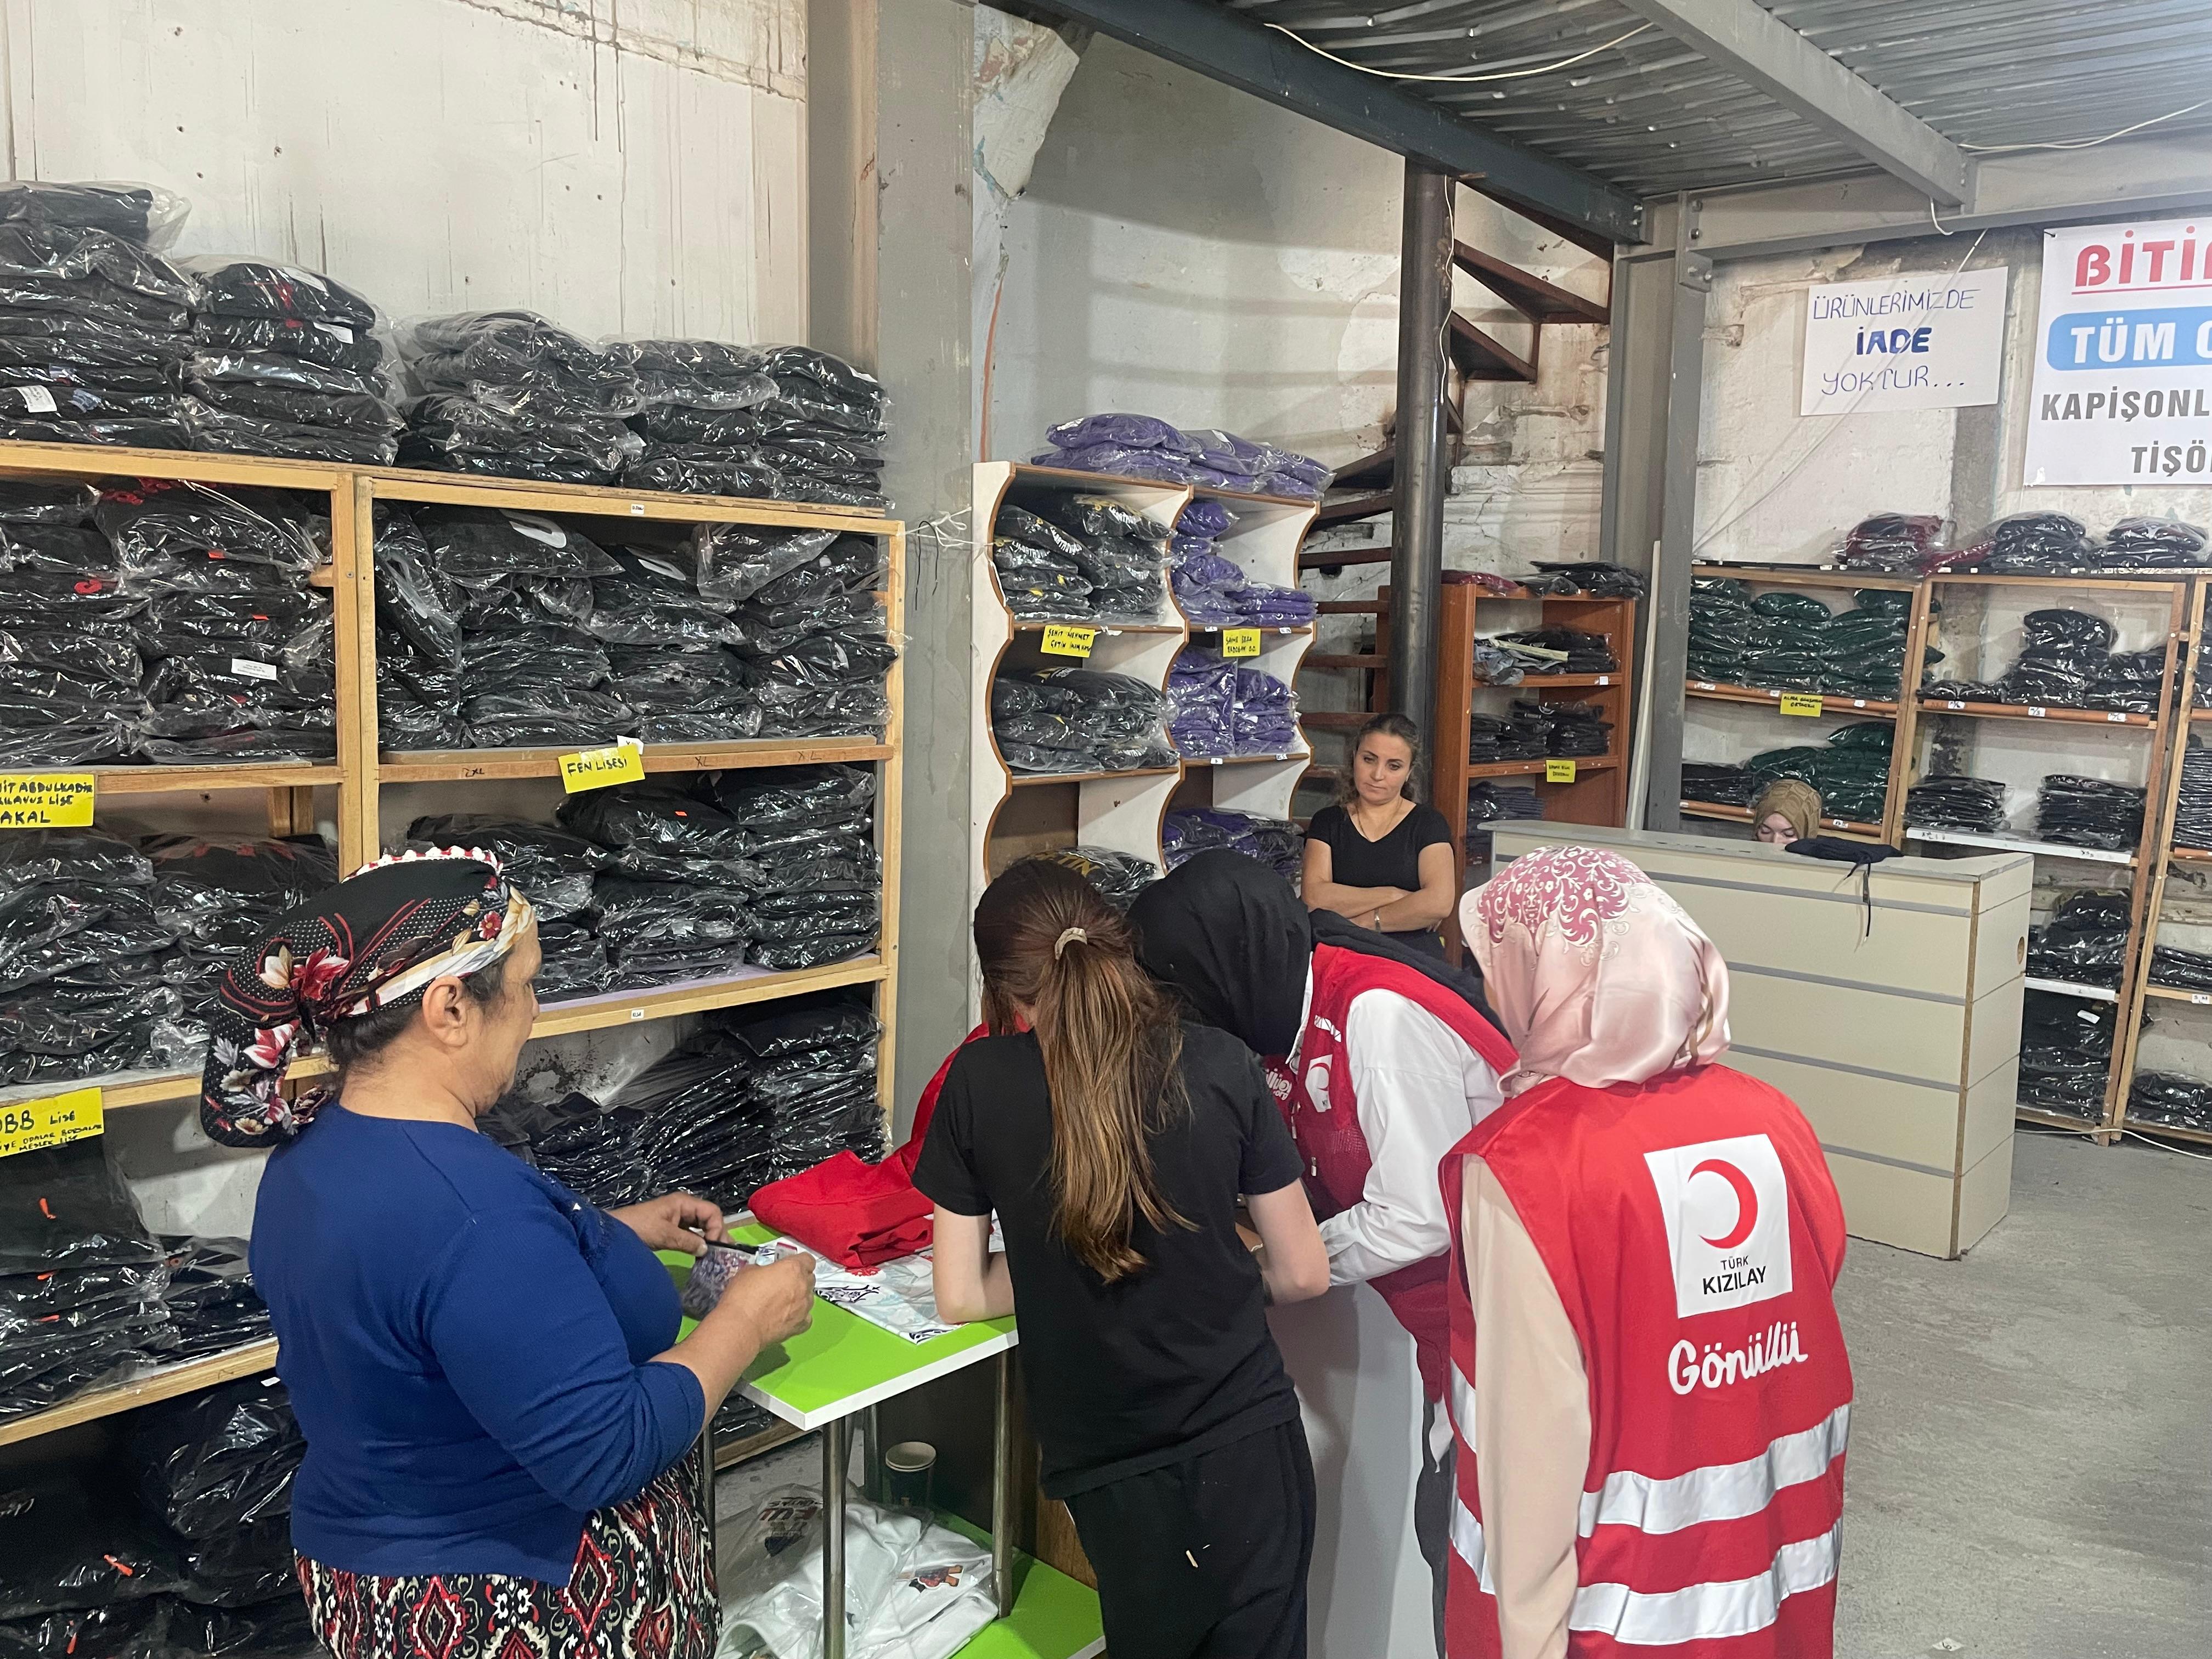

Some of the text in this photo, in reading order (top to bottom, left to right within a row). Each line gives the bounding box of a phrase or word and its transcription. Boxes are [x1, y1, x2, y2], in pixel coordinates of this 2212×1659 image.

[2075, 225, 2212, 286] BİTİ
[1813, 289, 1981, 319] ÜRÜNLERİMİZDE
[1856, 326, 1932, 356] İADE
[2071, 317, 2176, 363] TÜM
[2131, 439, 2212, 477] TİŞÖ
[567, 761, 592, 777] FEN
[695, 755, 712, 768] XL
[0, 1109, 35, 1133] BB
[1720, 1255, 1749, 1270] TÜRK
[1703, 1266, 1767, 1295] KIZILAY
[1668, 1321, 1809, 1395] Gönüllü
